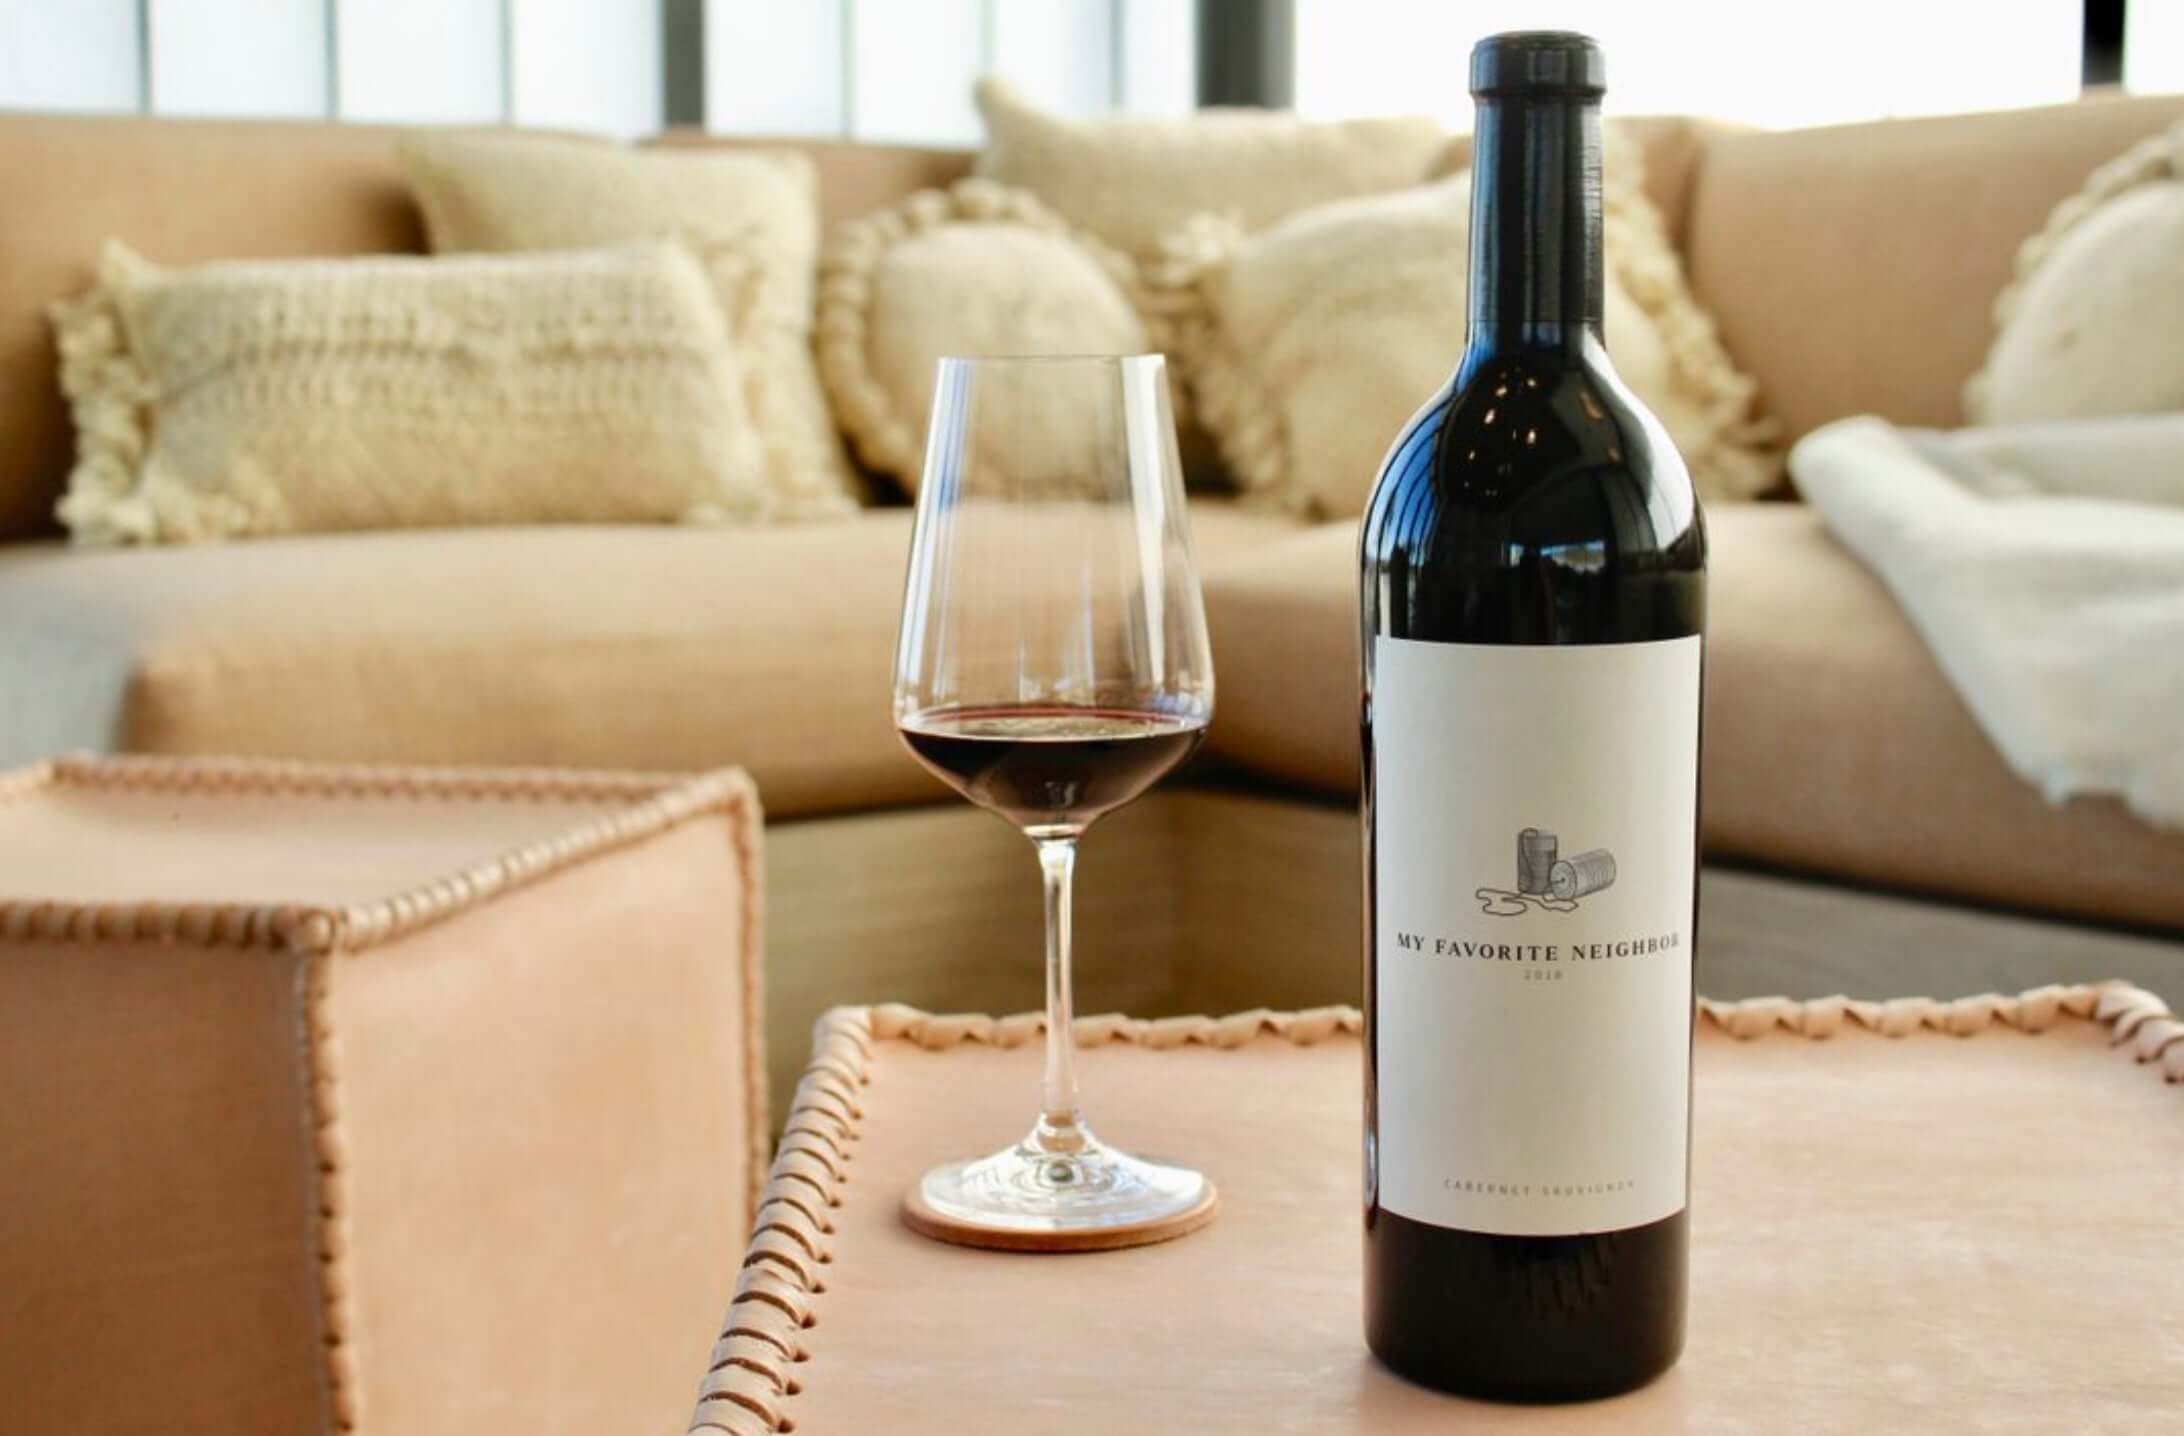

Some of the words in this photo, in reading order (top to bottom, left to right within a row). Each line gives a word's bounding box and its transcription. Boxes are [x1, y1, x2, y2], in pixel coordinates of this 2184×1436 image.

[1397, 931, 1425, 951] MY
[1434, 939, 1558, 961] FAVORITE
[1571, 932, 1679, 961] NEIGHBOR
